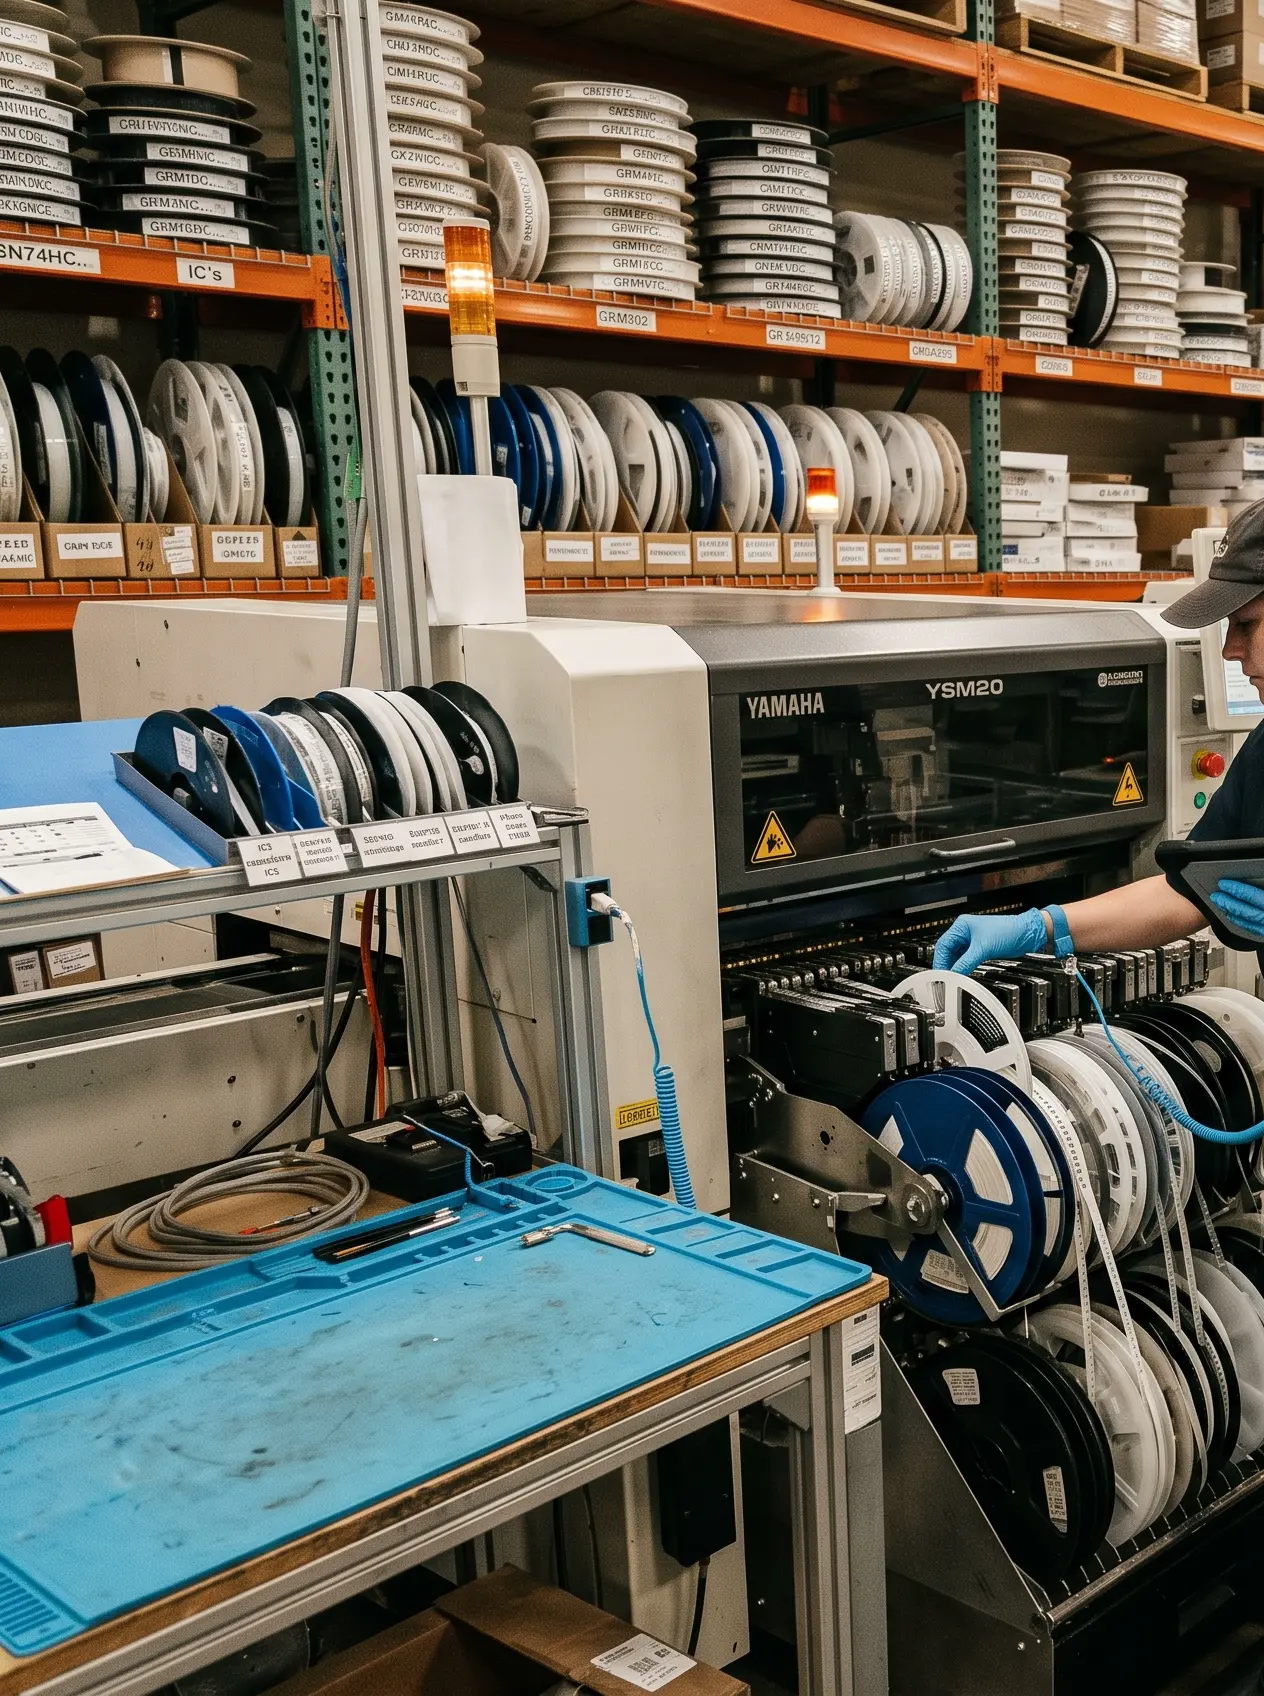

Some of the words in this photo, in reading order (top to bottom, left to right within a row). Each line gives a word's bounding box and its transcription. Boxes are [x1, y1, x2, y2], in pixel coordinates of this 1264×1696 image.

[188, 264, 222, 281] IC's
[925, 678, 1004, 700] YSM20
[747, 692, 825, 719] YAMAHA
